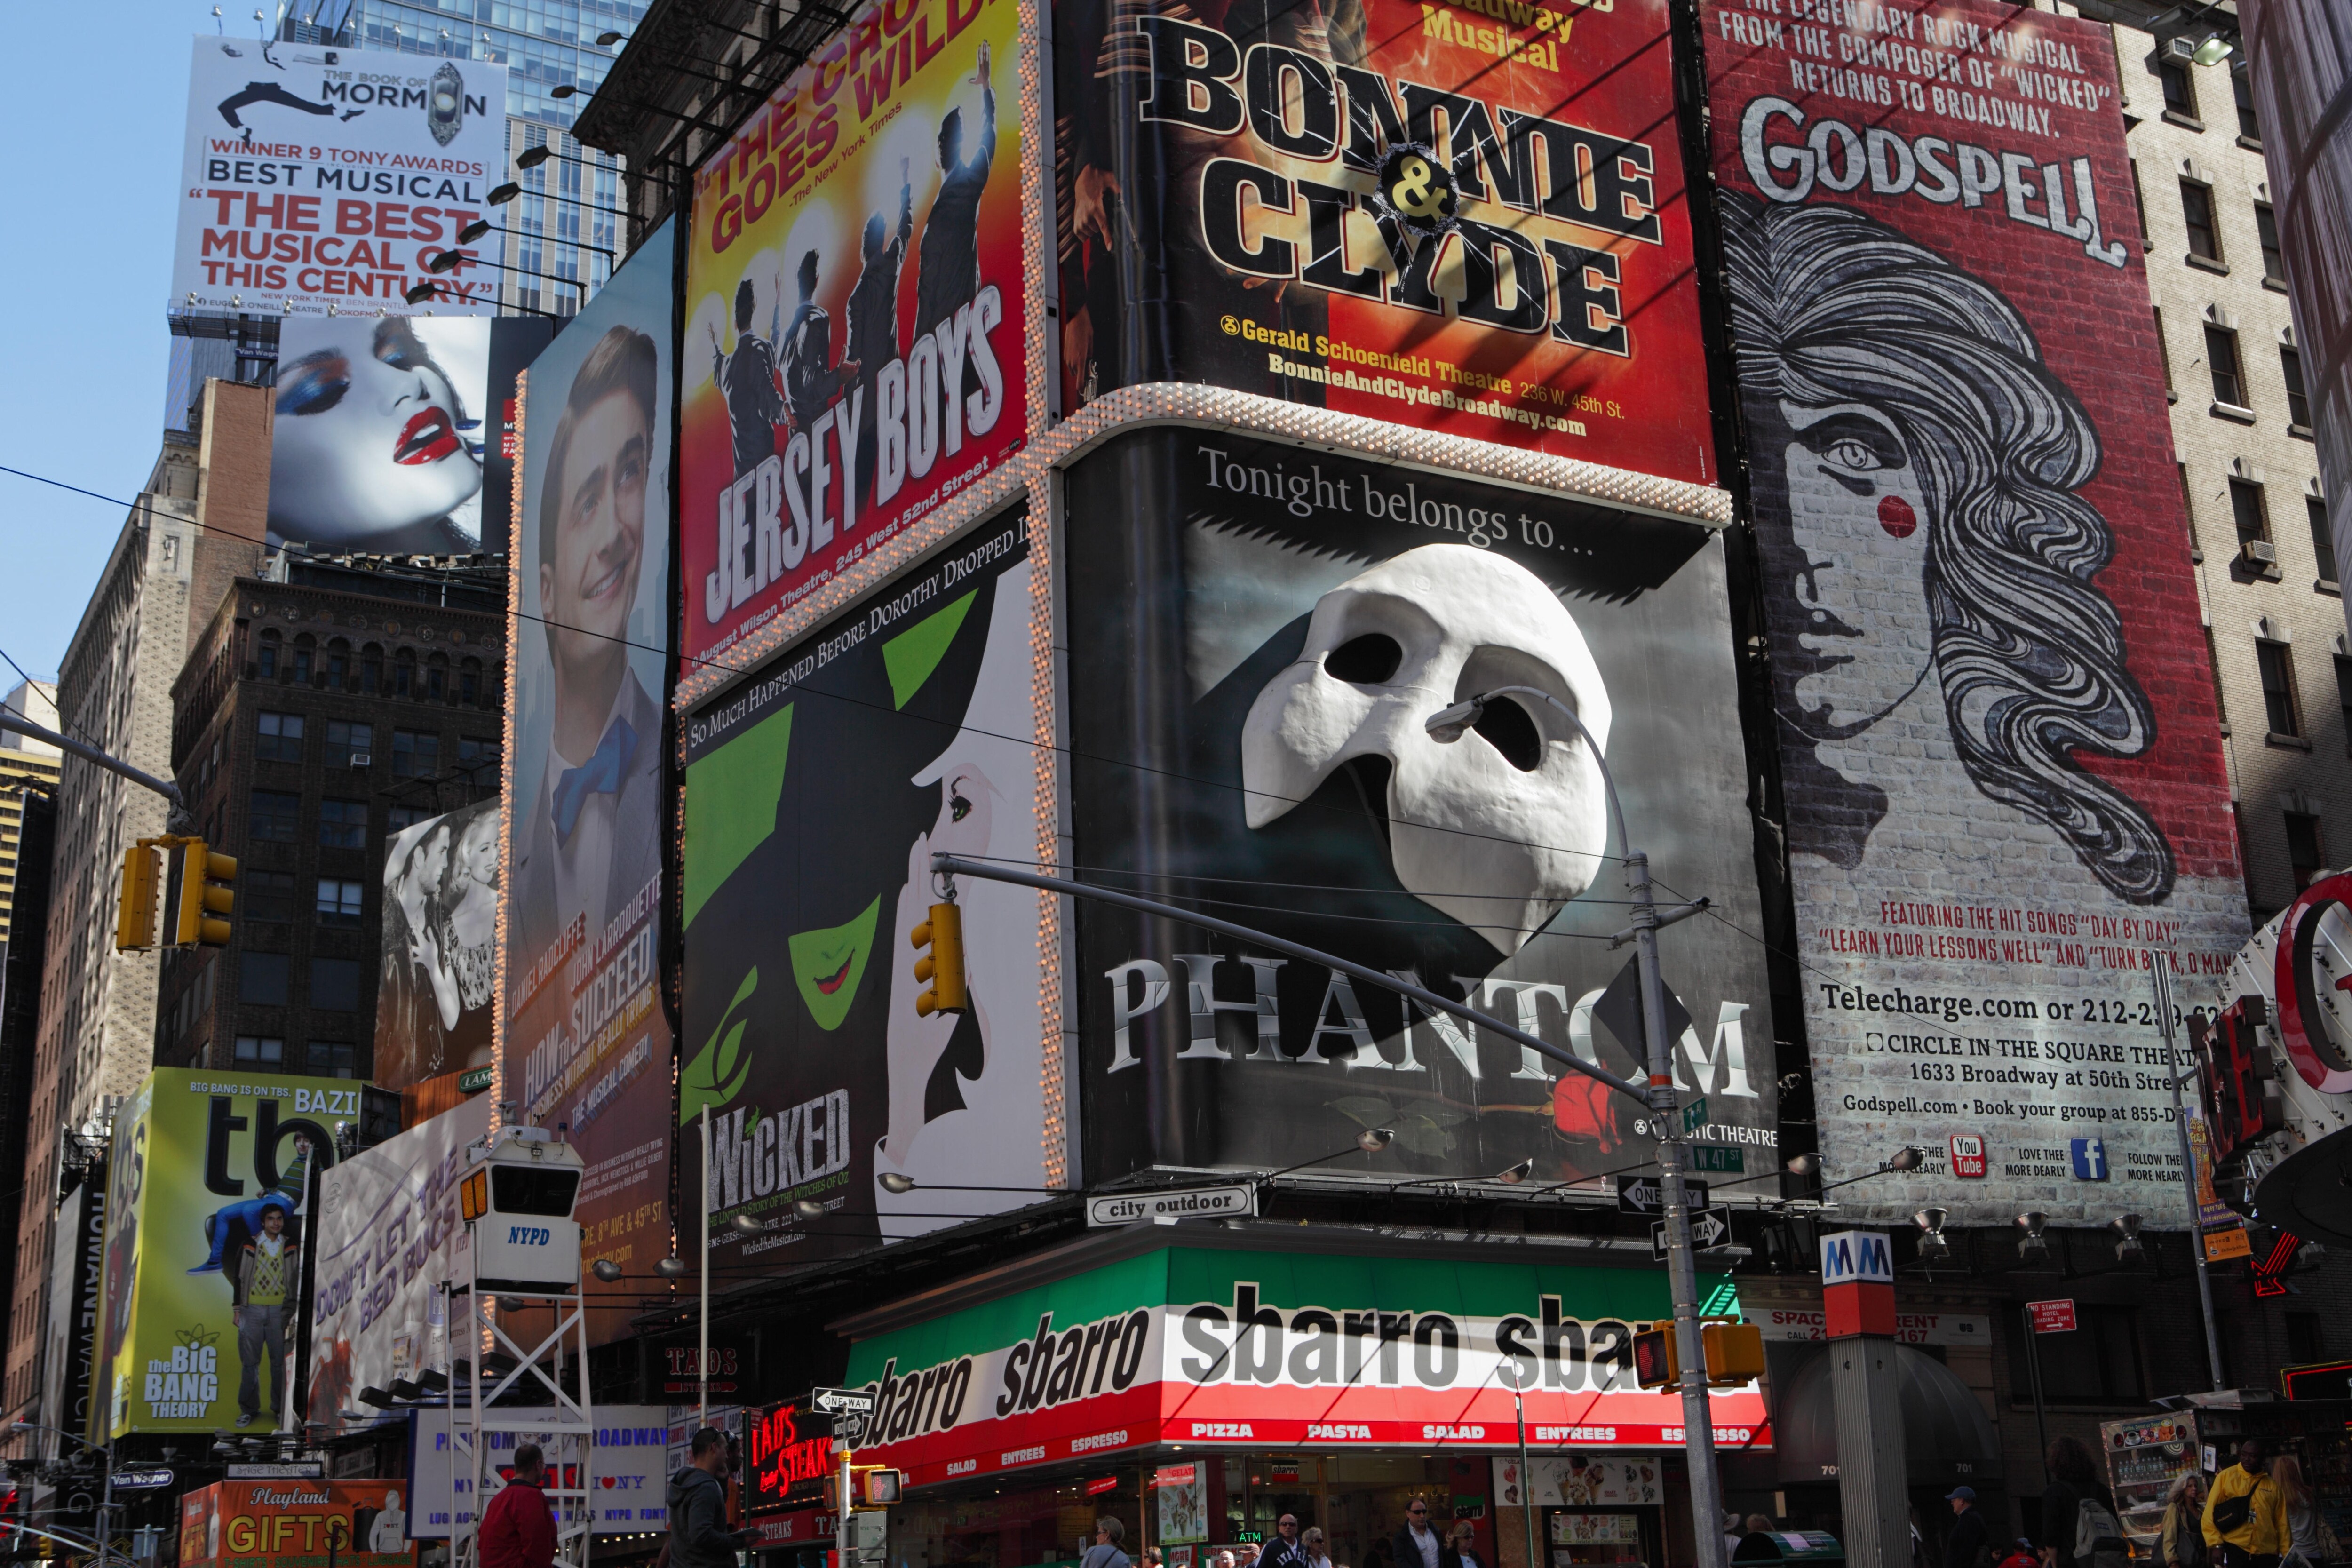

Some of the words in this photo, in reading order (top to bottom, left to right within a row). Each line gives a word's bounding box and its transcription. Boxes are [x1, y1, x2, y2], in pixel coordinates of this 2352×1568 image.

[1421, 4, 1559, 73] Musical
[1719, 10, 1784, 50] FROM
[1790, 24, 1832, 59] THE
[1839, 32, 1961, 83] COMPOSER
[1970, 59, 1995, 89] OF
[1789, 0, 1914, 40] LEGENDARY
[1923, 14, 1984, 53] ROCK
[1990, 29, 2085, 75] MUSICAL
[323, 70, 352, 81] THE
[358, 72, 401, 85] BOOK
[406, 78, 427, 88] OF
[1790, 59, 1891, 106] RETURNS
[1897, 79, 1926, 112] TO
[1933, 87, 2060, 138] BROADWAY.
[814, 159, 839, 188] New
[842, 135, 866, 161] York
[869, 101, 903, 137] Times
[1137, 15, 1662, 246] BONNIE
[211, 139, 302, 159] WINNER
[309, 146, 322, 160] 9
[328, 148, 389, 165] TONY
[390, 155, 484, 176] AWARDS
[208, 159, 302, 186] BEST
[316, 168, 482, 204] MUSICAL
[712, 104, 839, 253] GOES
[1740, 96, 2129, 270] GODSPELL
[336, 199, 479, 244] BEST
[201, 229, 405, 271] MUSICAL
[1200, 157, 1629, 357] CLYDE
[200, 260, 288, 290] THIS
[261, 292, 283, 301] NEW
[286, 294, 312, 302] YORK
[314, 296, 341, 304] TIMES
[1242, 318, 1310, 352] Gerald
[1316, 335, 1430, 378] Schoenfeld
[1436, 360, 1512, 395] Theatre
[1520, 382, 1547, 403] 236
[1550, 389, 1568, 406] W.
[1572, 394, 1603, 415] 45th
[1606, 402, 1625, 420] St.
[1269, 353, 1586, 437] BonnieAndClydeBroadway.com
[706, 384, 864, 623] JERSEY
[877, 285, 1003, 508] BOYS
[1198, 446, 1352, 517] Tonight
[1360, 474, 1508, 549] belongs
[699, 631, 738, 661] August
[740, 604, 778, 636] Wilson
[780, 569, 833, 609] Theatre,
[836, 546, 863, 572] 245
[866, 519, 899, 549] West
[902, 490, 938, 525] 52nd
[942, 455, 989, 498] Street
[1882, 901, 1963, 928] FEATURING
[1968, 907, 1994, 930] THE
[1999, 909, 2022, 932] HIT
[2027, 910, 2076, 936] SONGS
[2123, 918, 2139, 940] BY
[512, 966, 537, 1018] DANIEL
[539, 910, 583, 984] RADCLIFFE
[571, 944, 593, 990] JOHN
[1884, 932, 1925, 957] YOUR
[1929, 934, 1998, 961] LESSONS
[2057, 943, 2085, 967] AND
[2188, 952, 2197, 974] O
[524, 1020, 560, 1108] HOW
[571, 923, 651, 1056] SUCCEED
[1820, 984, 2038, 1023] Telecharge.com
[2047, 1001, 2074, 1020] or
[564, 1040, 596, 1091] WITHOUT
[598, 1010, 624, 1057] REALLY
[626, 981, 652, 1027] TRYING
[1888, 1035, 1963, 1055] CIRCLE
[1970, 1038, 1990, 1056] IN
[1997, 1040, 2039, 1058] THE
[2045, 1041, 2124, 1063] SQUARE
[191, 1082, 209, 1092] BIG
[211, 1083, 238, 1095] BANG
[240, 1085, 251, 1095] IS
[254, 1086, 268, 1096] ON
[270, 1087, 291, 1097] TBS.
[587, 1067, 617, 1115] MUSICAL
[619, 1033, 649, 1082] COMEDY
[1911, 1063, 1955, 1081] 1633
[1962, 1064, 2058, 1090] Broadway
[2066, 1070, 2083, 1086] at
[2090, 1070, 2130, 1089] 50th
[1844, 1095, 1958, 1115] Godspell.com
[1973, 1099, 2015, 1115] Book
[2019, 1104, 2055, 1120] your
[2061, 1106, 2106, 1122] group
[2112, 1106, 2126, 1120] at
[1718, 1125, 1778, 1147] THEATRE
[1957, 1138, 1977, 1154] You
[1697, 1148, 1707, 1169] W
[1712, 1149, 1725, 1169] 47
[1730, 1150, 1739, 1161] ST
[1956, 1157, 1982, 1174] Tube
[2005, 1164, 2031, 1176] MORE
[2034, 1165, 2066, 1177] DEARLY
[2019, 1149, 2041, 1160] LOVE
[2044, 1150, 2064, 1161] THEE
[2128, 1153, 2162, 1166] FOLLOW
[2128, 1169, 2152, 1181] MORE
[1110, 1201, 1145, 1218] city
[1156, 1194, 1232, 1213] outdoor
[376, 1202, 411, 1274] LET
[508, 1226, 550, 1246] NYPD
[1694, 1221, 1717, 1239] WAY
[360, 1266, 397, 1333] BED
[404, 1192, 455, 1287] BUGS
[1181, 1285, 1458, 1388] sbarro
[1788, 1331, 1807, 1340] CALL
[996, 1311, 1149, 1417] sbarro
[144, 1373, 218, 1403] BANG
[825, 1397, 842, 1406] ONE
[849, 1398, 867, 1408] WAY
[151, 1402, 208, 1419] THEORY
[1192, 1423, 1254, 1437] PIZZA
[1308, 1425, 1372, 1439] PASTA
[1423, 1425, 1485, 1439] SALAD
[1536, 1427, 1616, 1440] ENTREES
[268, 1466, 312, 1475] THEATER
[946, 1459, 977, 1476] SALAD
[1001, 1446, 1045, 1465] ENTREES
[1071, 1430, 1128, 1452] ESPRESSO
[1272, 1465, 1298, 1475] sbarro
[111, 1476, 130, 1485] Van
[133, 1473, 170, 1487] Wagner
[250, 1487, 330, 1510] Playland
[226, 1514, 349, 1552] GIFTS
[605, 1509, 631, 1520] NYPD
[641, 1509, 666, 1520] FDNY
[1239, 1532, 1262, 1542] ATM
[275, 1556, 328, 1568] SOUVENIRS
[367, 1554, 412, 1566] LUGGAGE
[1168, 1550, 1189, 1562] MORE
